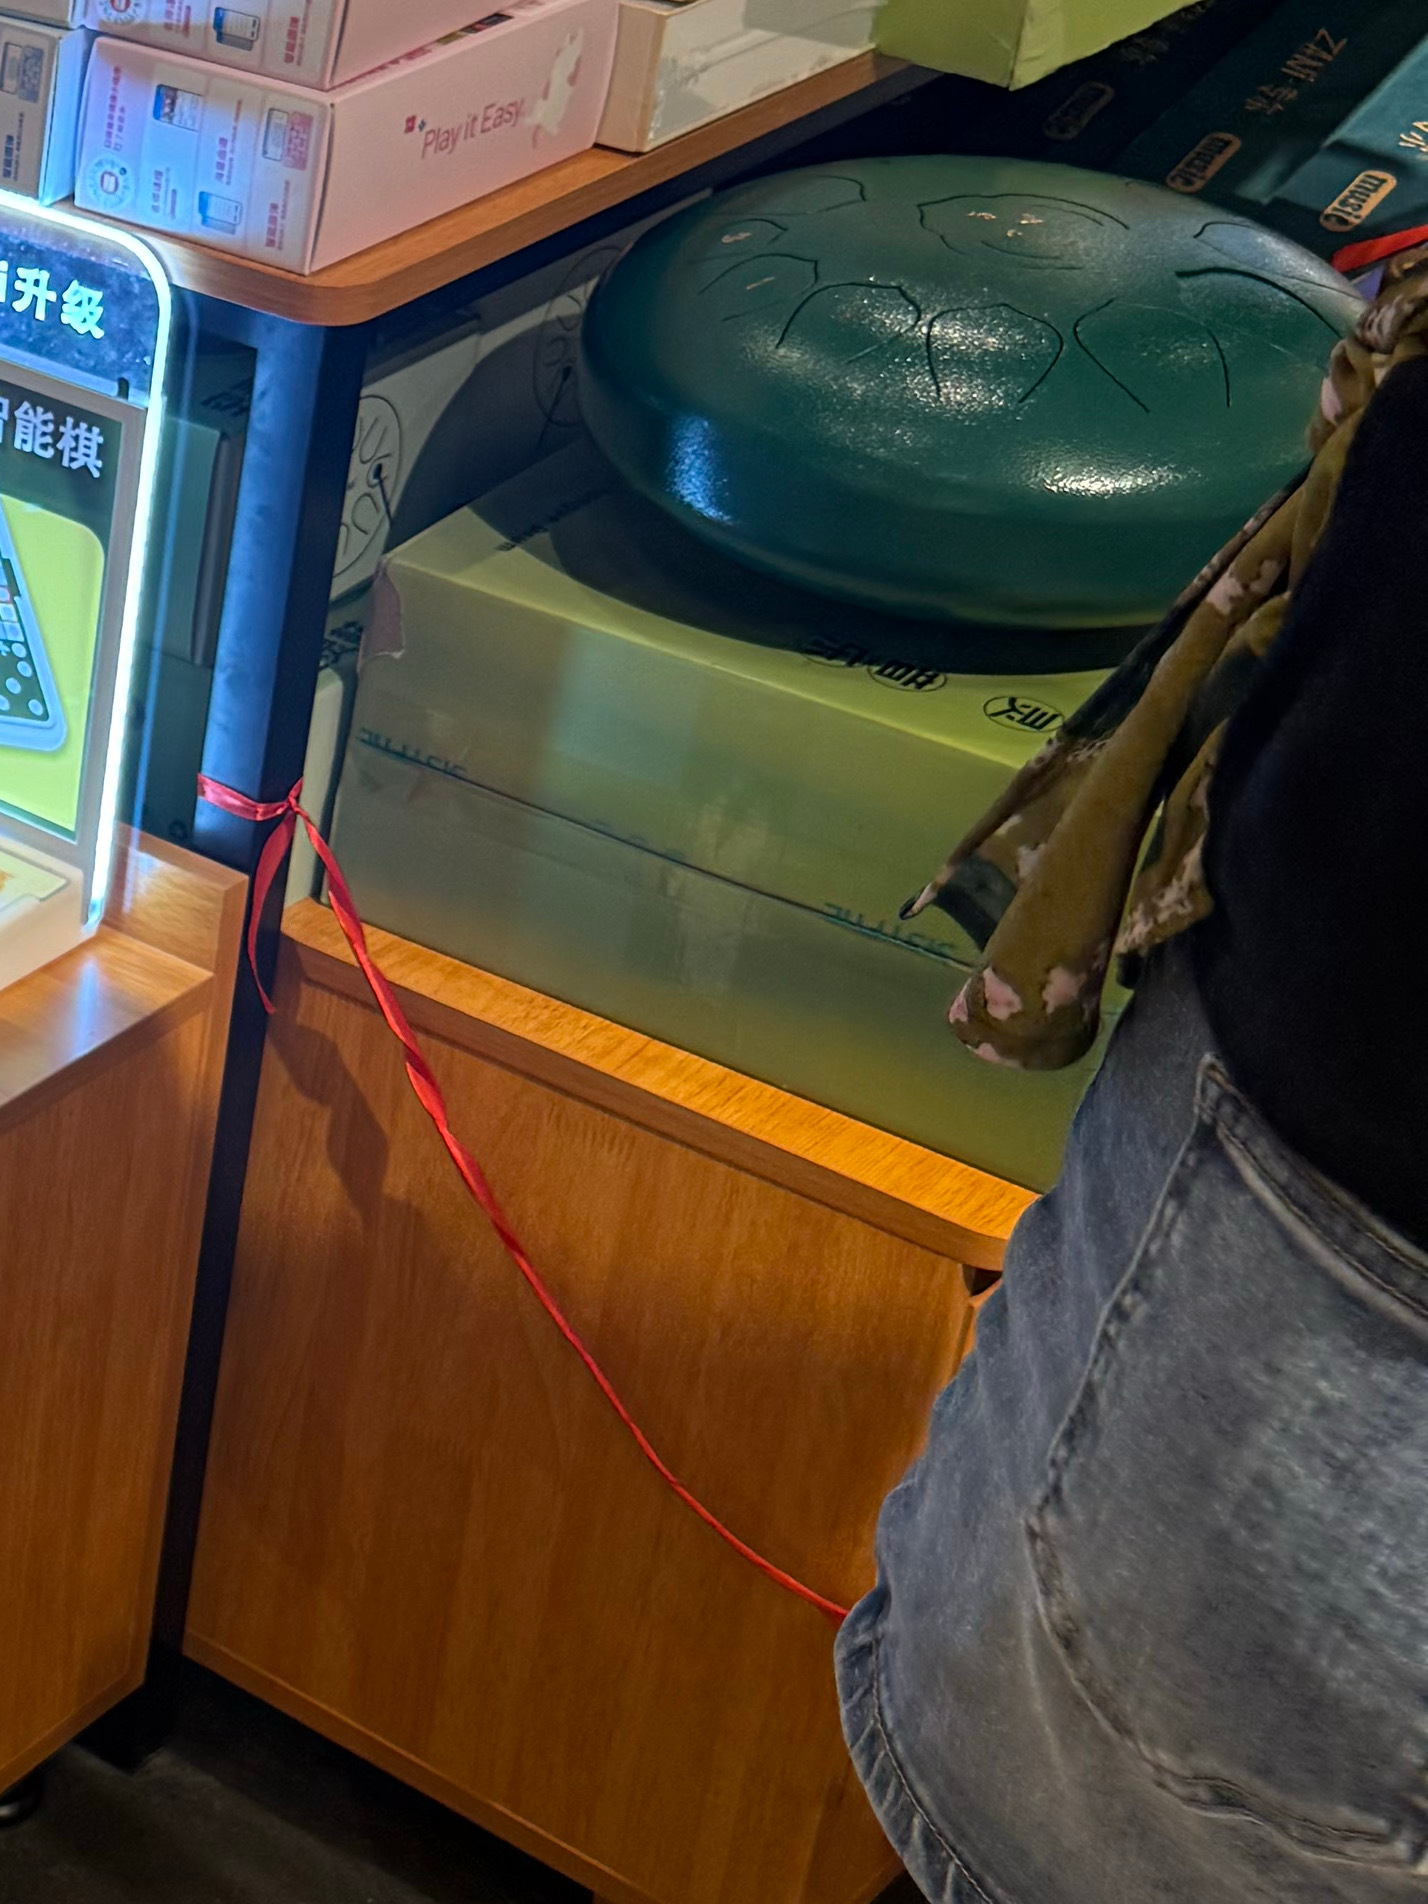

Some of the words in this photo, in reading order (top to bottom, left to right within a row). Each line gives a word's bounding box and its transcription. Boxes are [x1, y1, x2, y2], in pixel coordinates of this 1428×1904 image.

[420, 122, 458, 160] Play
[462, 115, 477, 143] it
[479, 102, 527, 139] Easy
[1323, 176, 1386, 227] music
